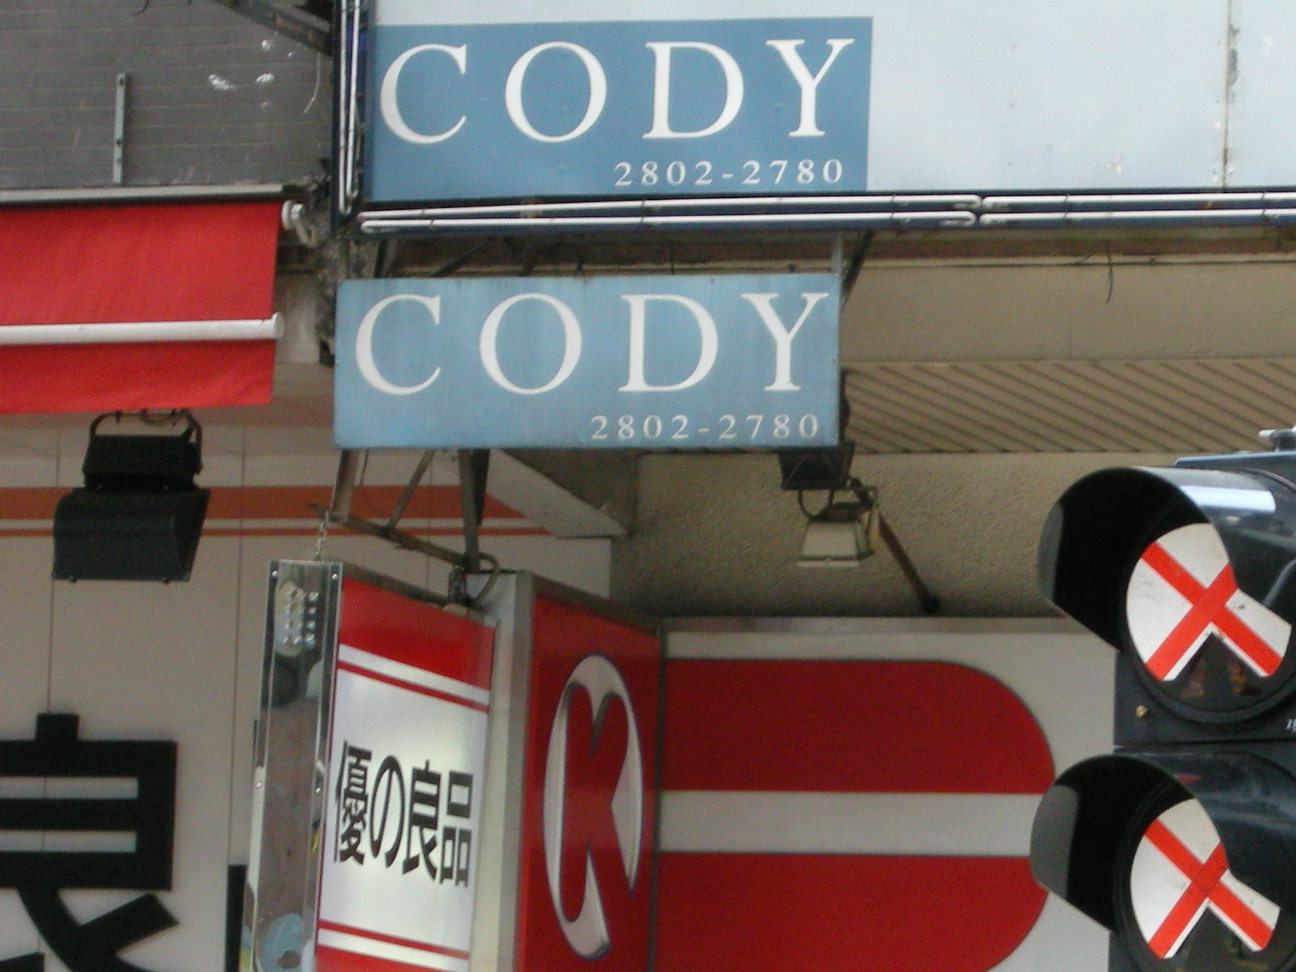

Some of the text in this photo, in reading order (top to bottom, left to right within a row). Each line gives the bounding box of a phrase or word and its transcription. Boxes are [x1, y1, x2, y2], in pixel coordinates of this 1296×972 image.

[380, 38, 855, 144] CODY
[614, 159, 843, 187] 2802-2780
[355, 292, 830, 395] CODY
[590, 414, 819, 440] 2802-2780
[334, 742, 474, 888] 優の良品
